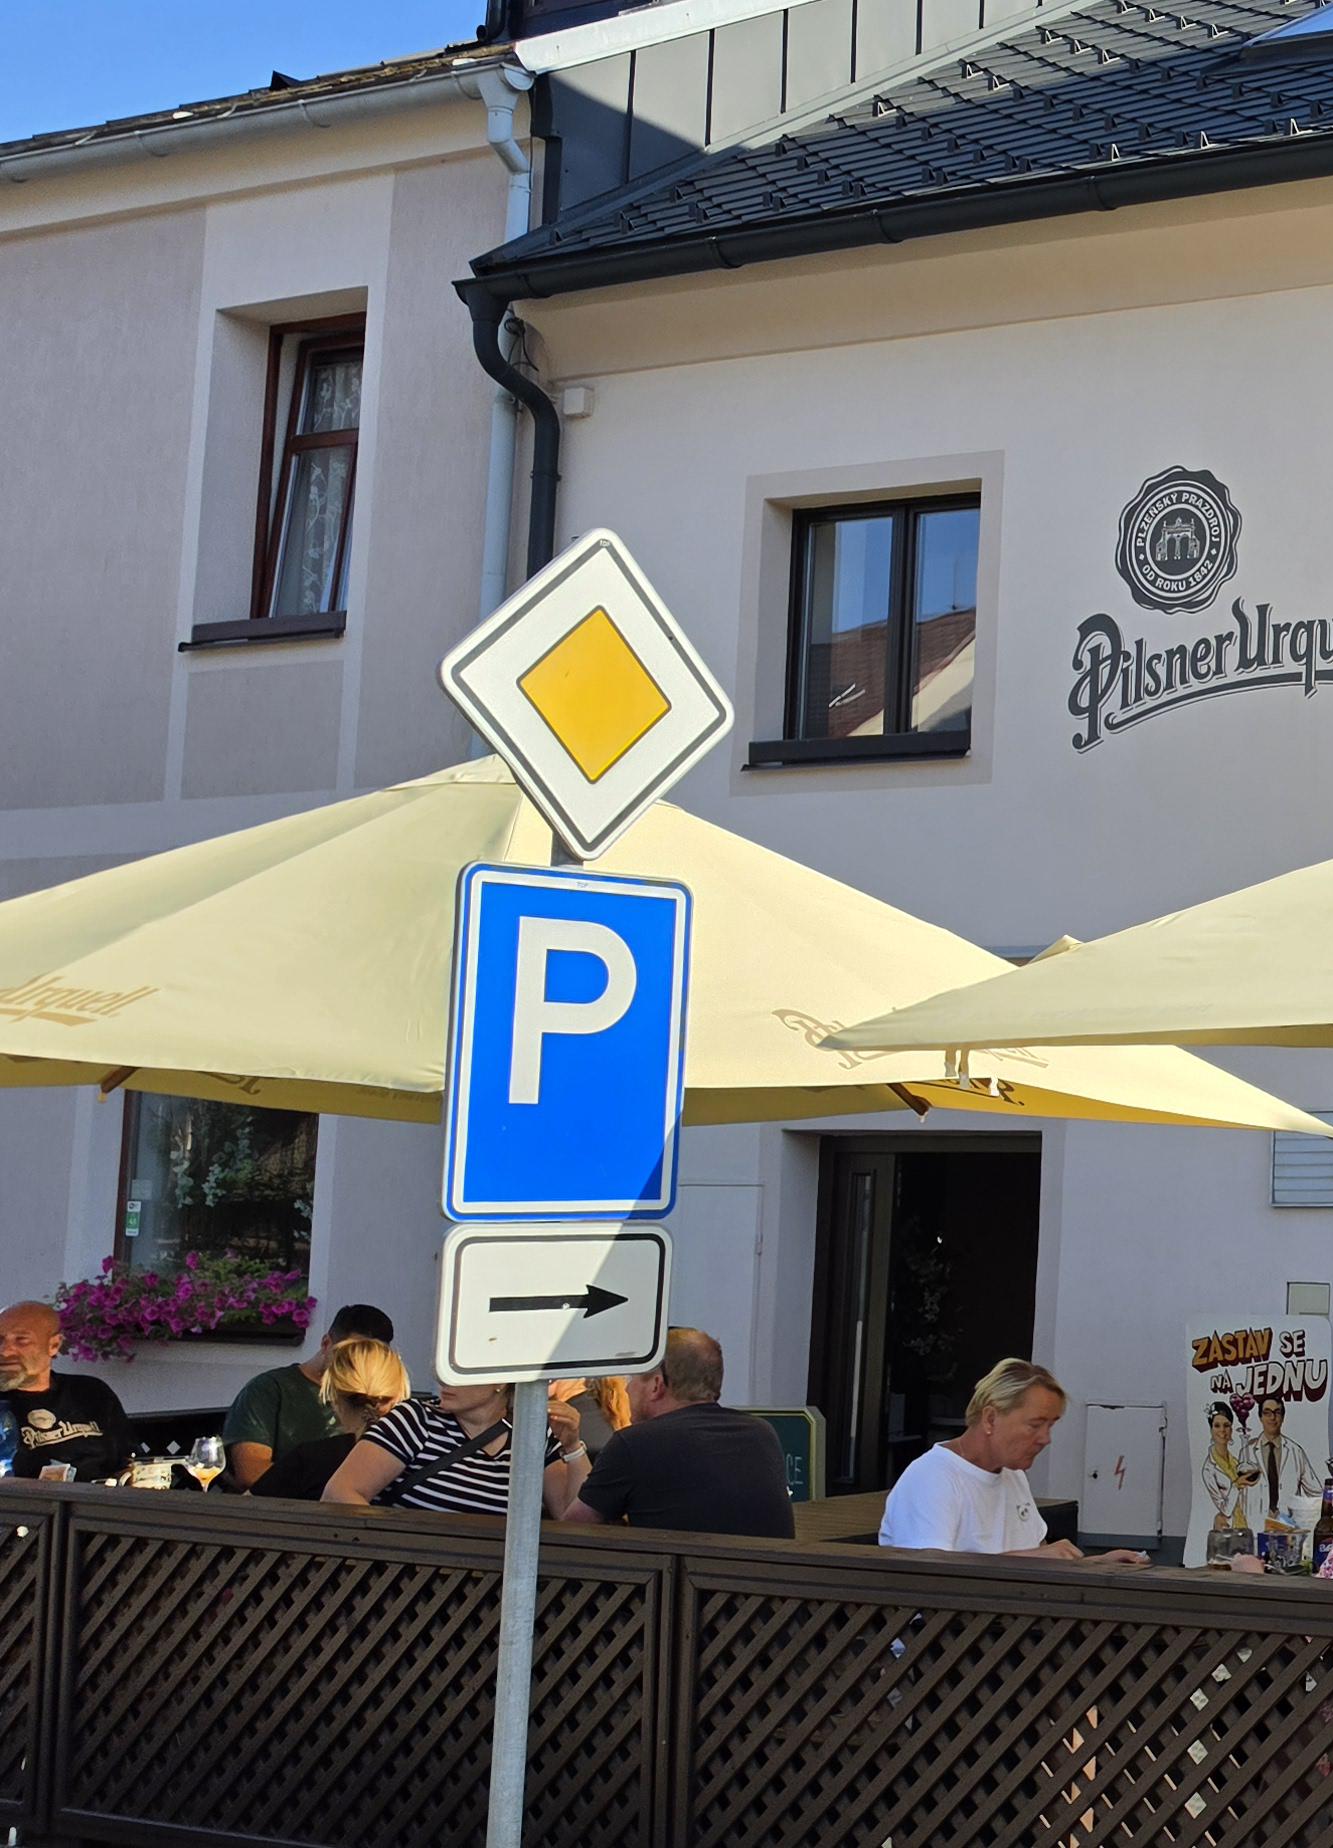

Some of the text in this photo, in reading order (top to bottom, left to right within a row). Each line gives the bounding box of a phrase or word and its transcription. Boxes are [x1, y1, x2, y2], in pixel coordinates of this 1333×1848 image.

[1182, 492, 1220, 542] PRAZDROJ
[1142, 560, 1213, 591] OD ROKU 1842
[1068, 613, 1236, 753] Pilsner
[508, 916, 637, 1104] P
[1192, 1327, 1305, 1372] ZASTAV SE
[1210, 1358, 1328, 1402] NA JEDNU
